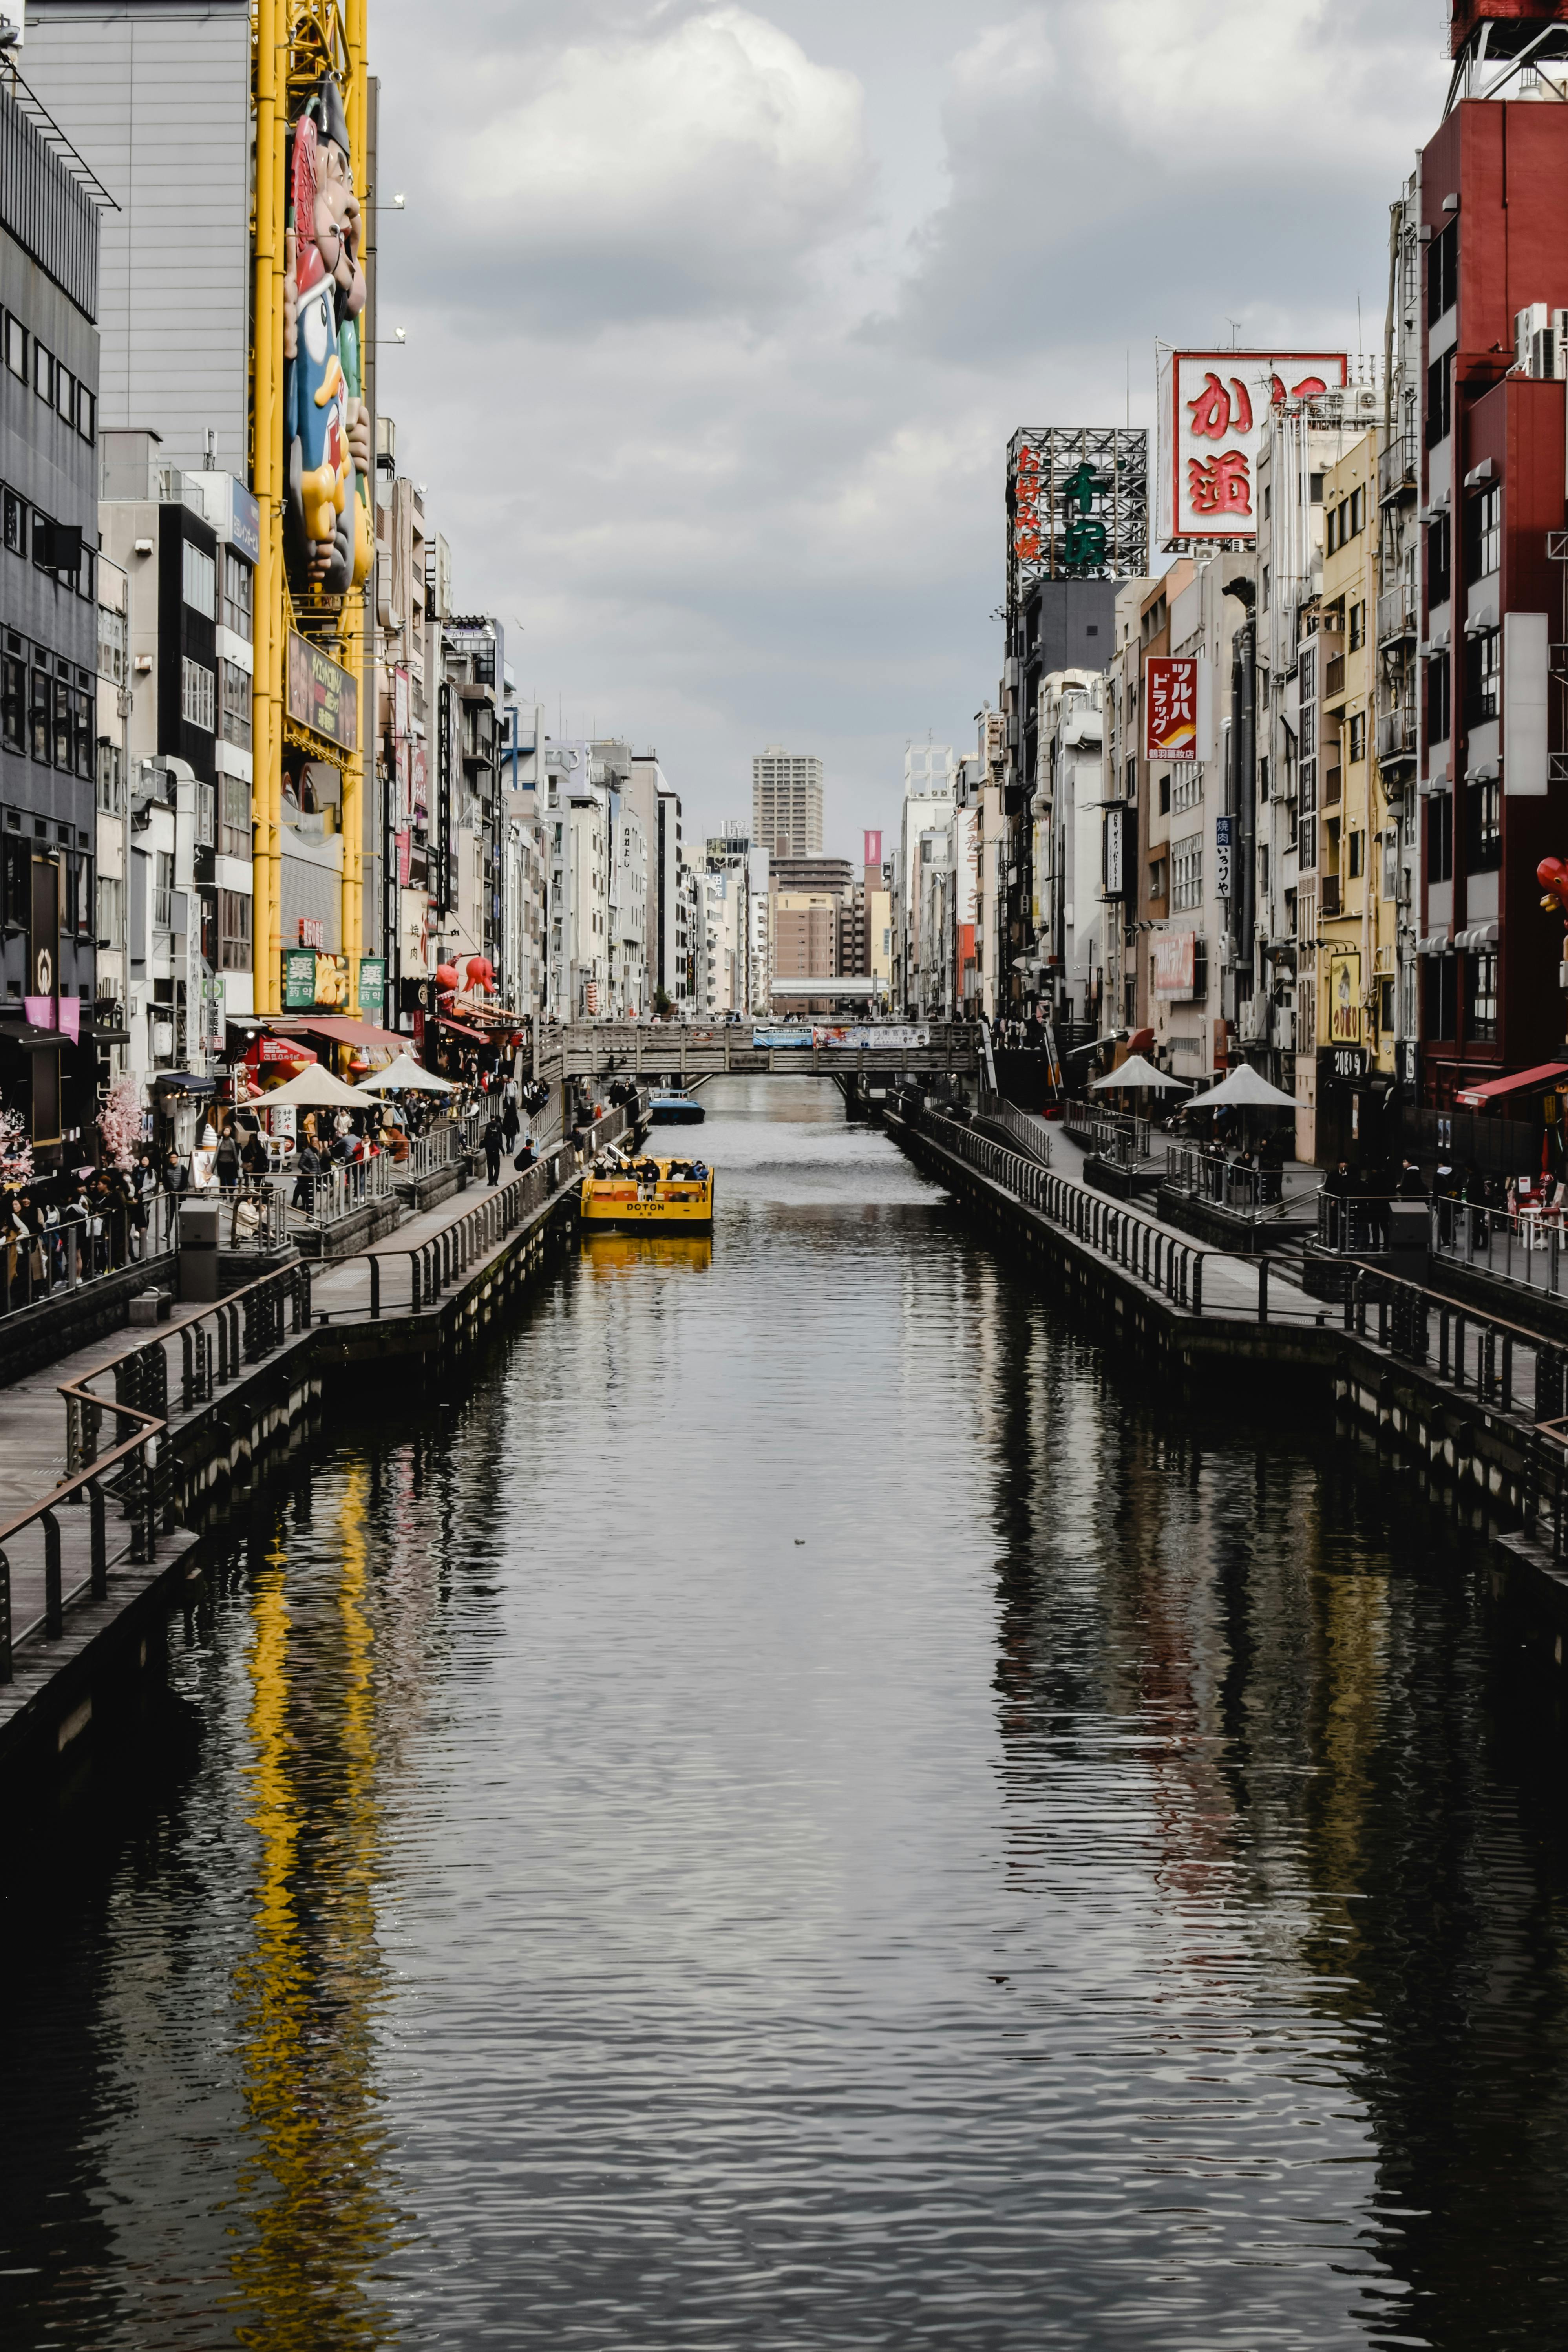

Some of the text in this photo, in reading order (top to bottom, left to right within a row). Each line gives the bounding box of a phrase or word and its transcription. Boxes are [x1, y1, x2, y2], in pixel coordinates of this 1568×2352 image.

[1188, 449, 1253, 516] 道
[1062, 462, 1109, 565] 千房
[1152, 673, 1170, 735] ドラッグ
[1171, 664, 1192, 720] ツルハ
[1217, 820, 1229, 844] 焼肉
[1217, 847, 1228, 895] いろりや
[410, 924, 420, 960] 焼肉
[289, 956, 313, 980] 薬
[362, 965, 382, 985] 薬
[283, 1109, 292, 1131] 神戸牛
